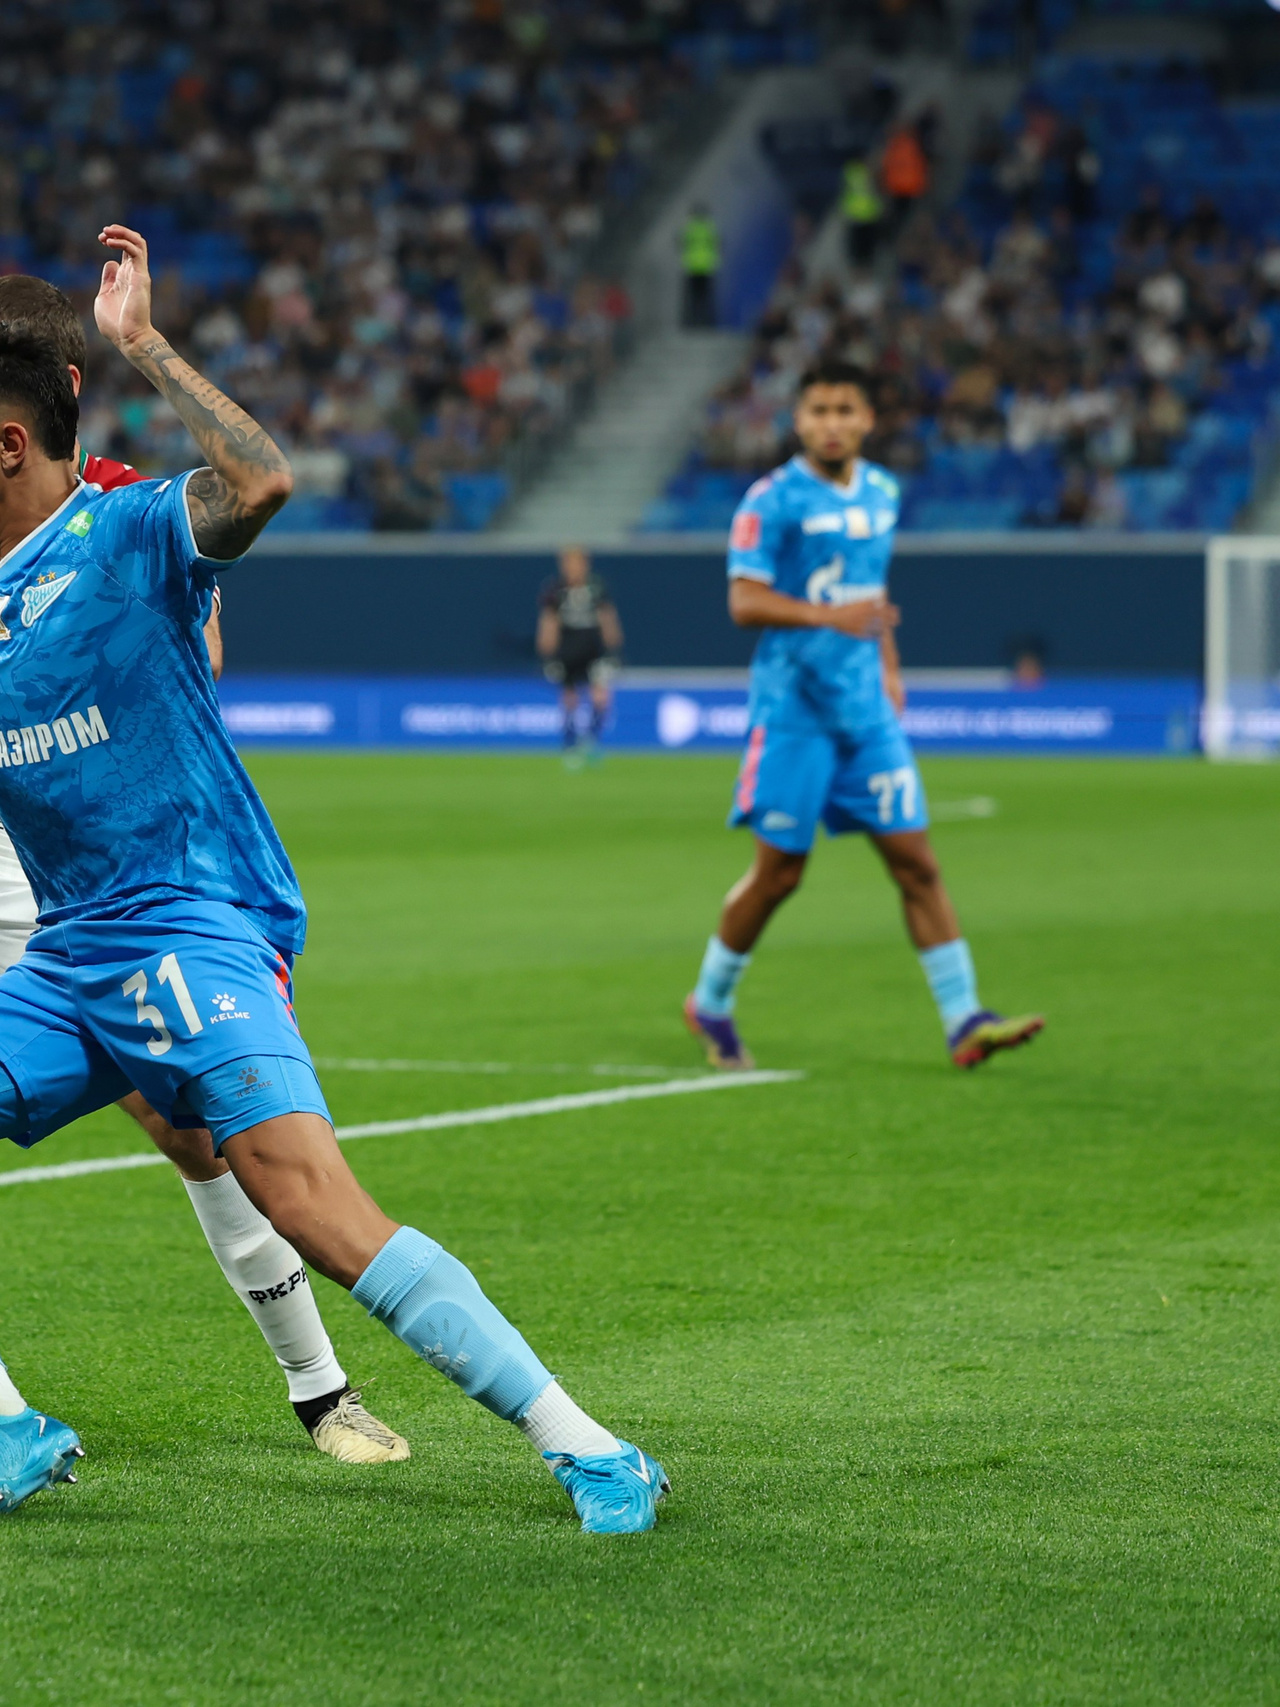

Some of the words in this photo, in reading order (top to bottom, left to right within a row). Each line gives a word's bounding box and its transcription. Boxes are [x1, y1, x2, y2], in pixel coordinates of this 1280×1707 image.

[867, 767, 916, 825] 77
[121, 952, 204, 1056] 31
[210, 1011, 251, 1025] KELME
